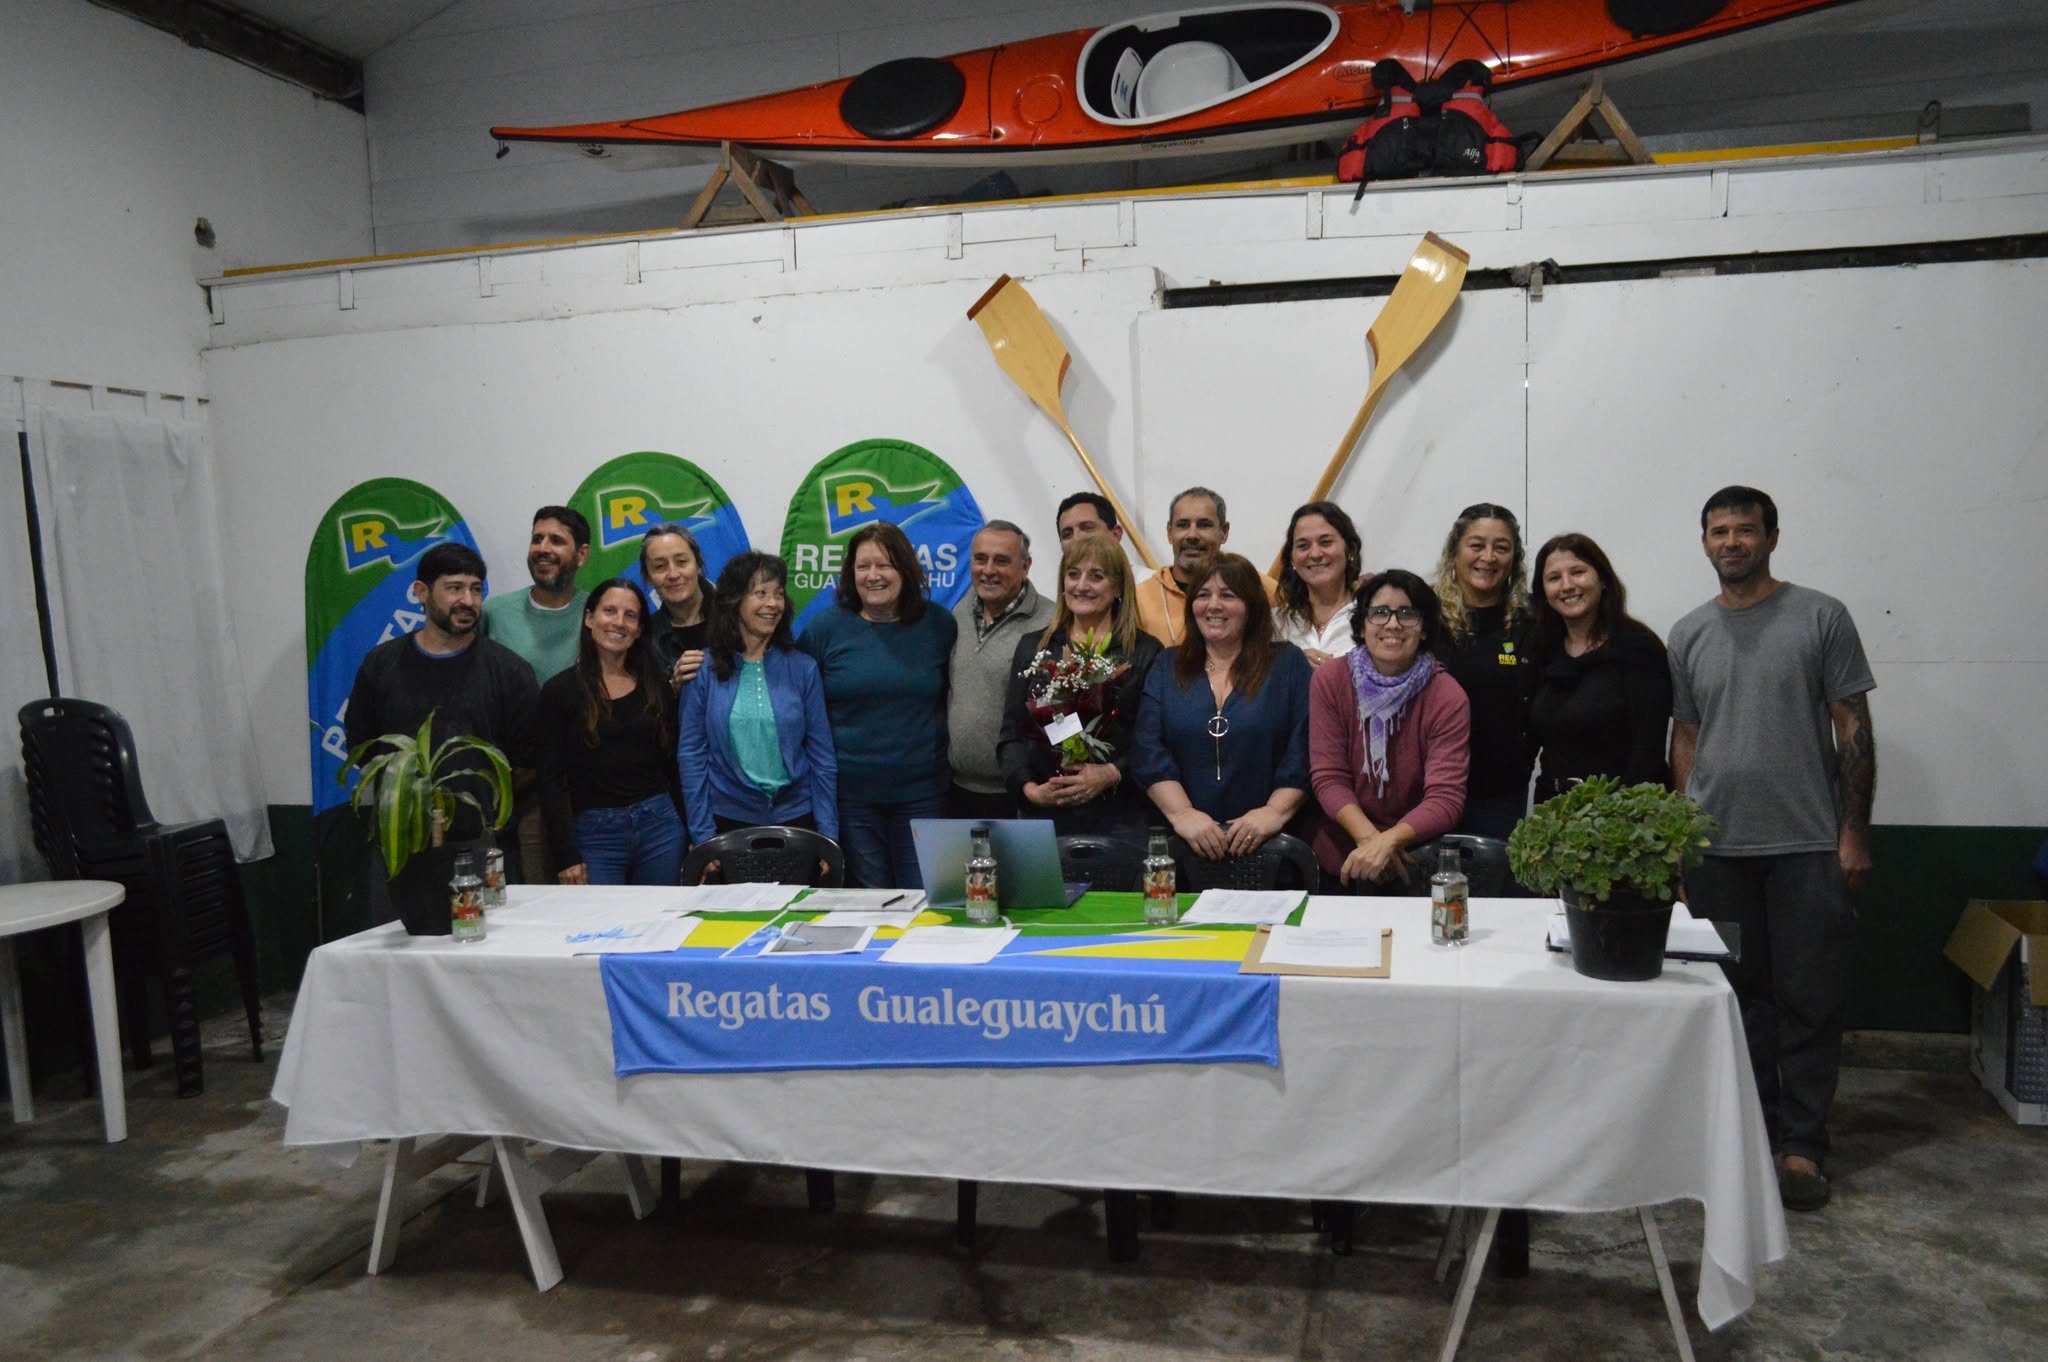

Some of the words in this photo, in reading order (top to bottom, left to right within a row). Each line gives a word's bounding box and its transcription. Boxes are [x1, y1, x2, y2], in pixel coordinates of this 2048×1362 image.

[609, 496, 648, 529] R
[835, 482, 877, 517] R
[351, 520, 388, 553] R
[666, 982, 831, 1030] Regatas
[858, 985, 1167, 1042] Gualeguaychú
